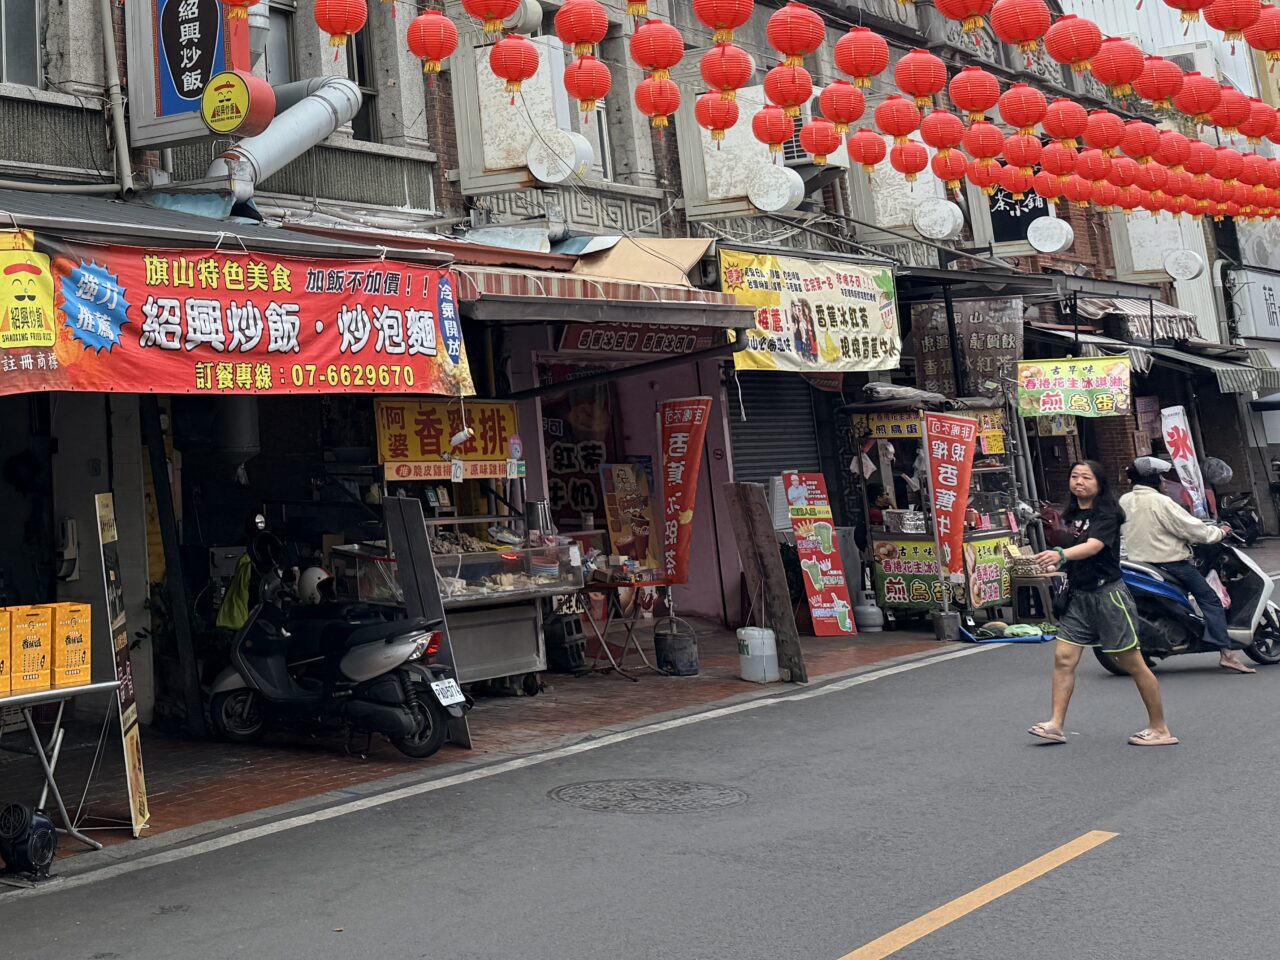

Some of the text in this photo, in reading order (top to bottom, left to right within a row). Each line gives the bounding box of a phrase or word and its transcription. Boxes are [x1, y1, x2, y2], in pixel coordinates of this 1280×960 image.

[143, 254, 293, 293] 旗山特色美食
[802, 276, 834, 293] 正宗第一名
[75, 272, 119, 310] 強力
[10, 306, 44, 330] 紹興炒飯
[76, 303, 115, 341] 推薦
[439, 277, 461, 357] 冷氣開放
[815, 304, 870, 330] 香蕉冰紅茶
[1, 352, 59, 372] 註冊商標
[924, 355, 1014, 376] 香紅茶
[1050, 364, 1096, 375] 古早味
[1024, 375, 1124, 391] 春捲花生冰淇淋
[1039, 391, 1116, 413] 煎鳥蛋
[385, 406, 408, 458] 阿婆
[898, 545, 935, 557] 古早味
[882, 559, 940, 574] 春捲花生冰
[884, 576, 953, 603] 煎鳥蛋
